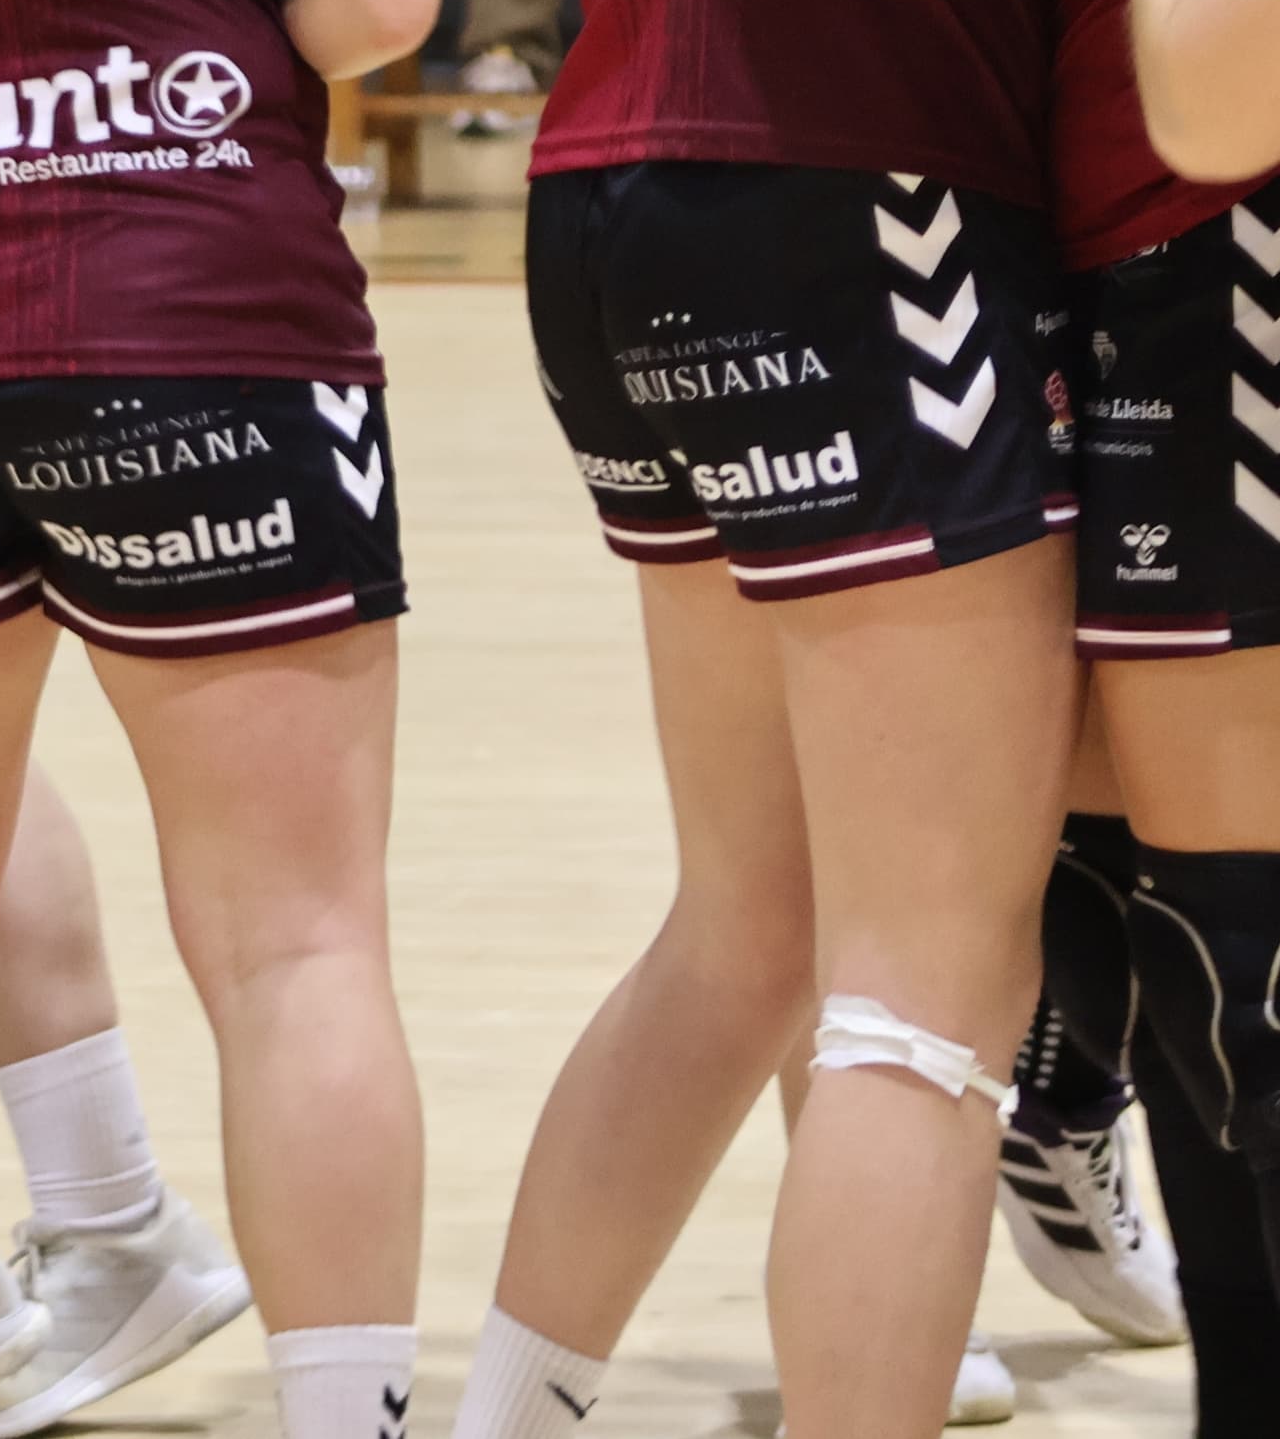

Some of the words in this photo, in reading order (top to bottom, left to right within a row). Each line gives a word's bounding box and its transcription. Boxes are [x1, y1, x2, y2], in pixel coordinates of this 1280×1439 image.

[195, 139, 254, 170] 24h
[1111, 397, 1175, 420] Lleida
[6, 422, 273, 491] LOUISIANA
[39, 497, 296, 570] Dissalud
